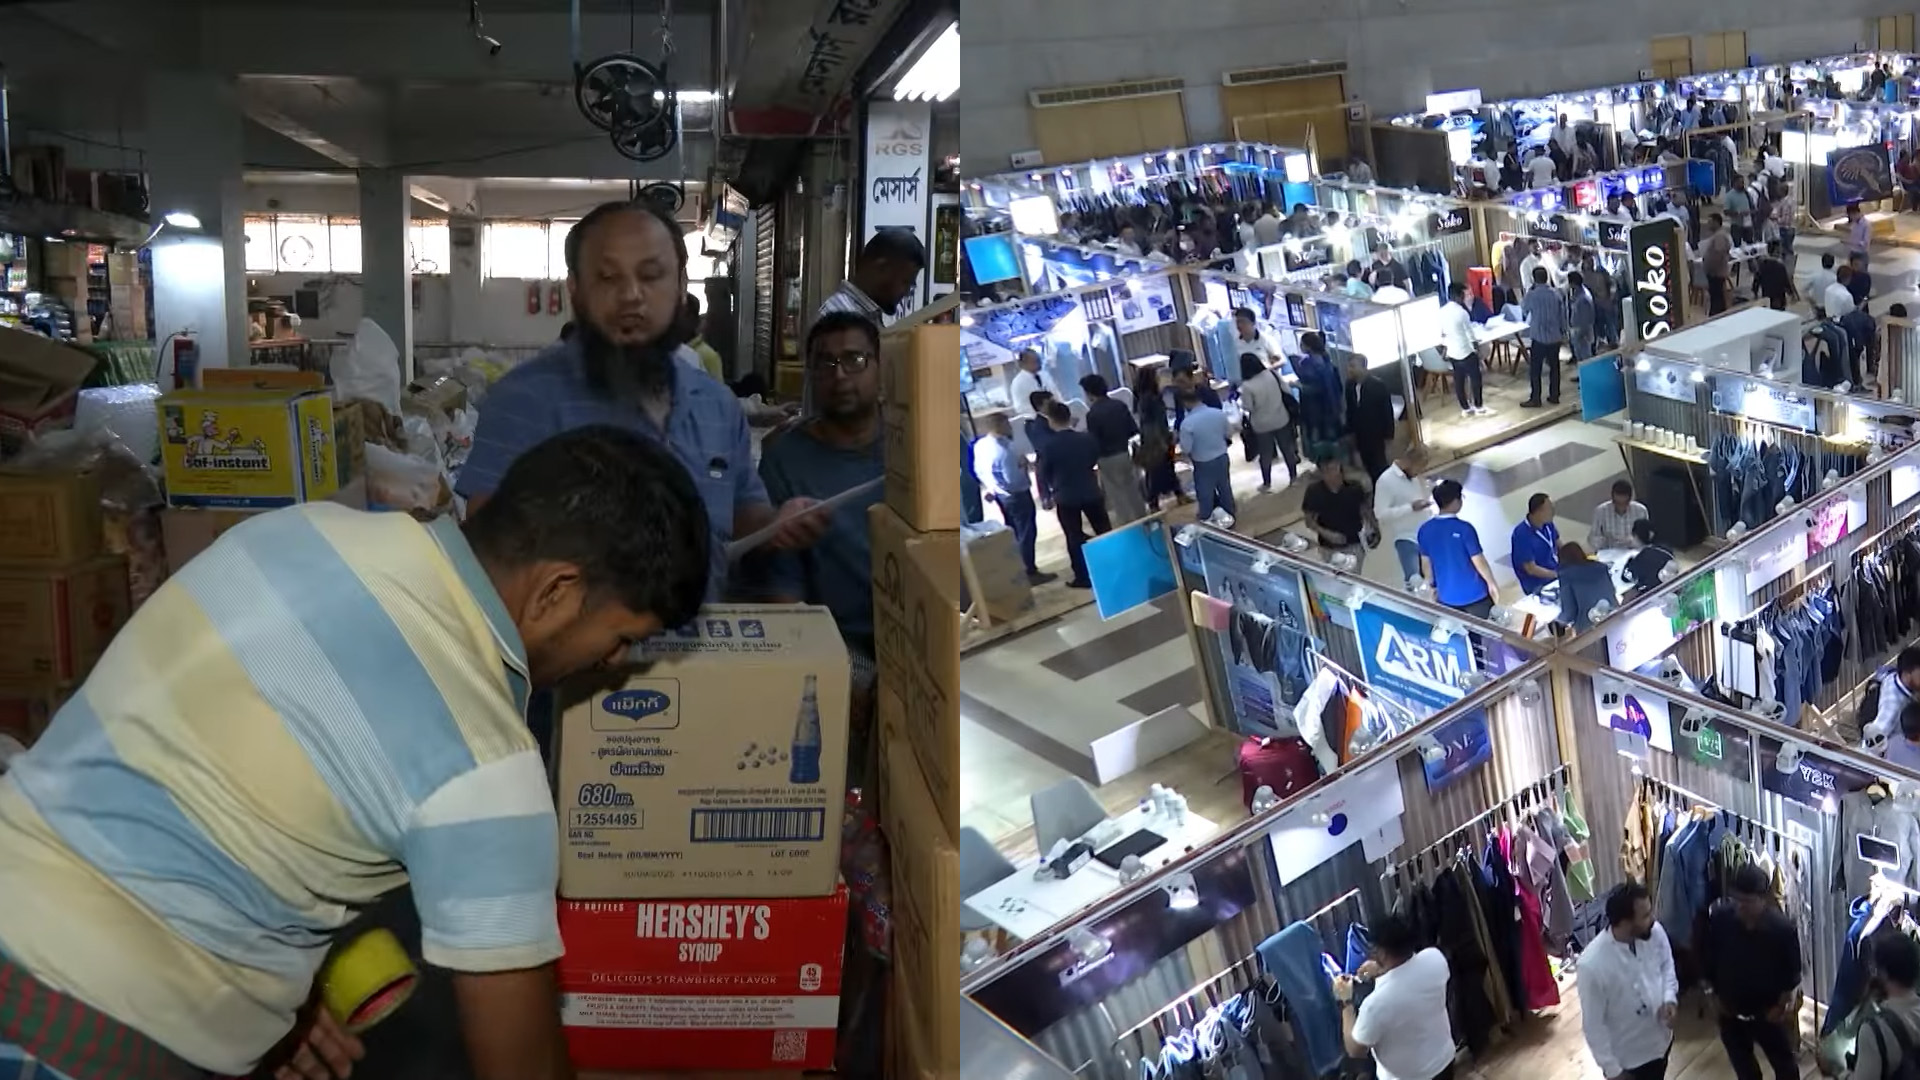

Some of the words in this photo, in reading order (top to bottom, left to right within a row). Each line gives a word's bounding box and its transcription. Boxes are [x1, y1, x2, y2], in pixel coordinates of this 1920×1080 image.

[875, 143, 923, 157] RGS
[873, 166, 922, 205] মেসার্স
[1607, 226, 1629, 242] Sok
[1637, 245, 1671, 341] Soko
[184, 457, 269, 469] saf-instant
[1376, 622, 1460, 688] ARM
[578, 783, 616, 807] 680
[576, 813, 638, 826] 12554495
[770, 850, 785, 858] LOT
[636, 902, 771, 940] HERSHEY'S
[678, 942, 723, 962] SYRUP
[591, 973, 652, 984] DELICIOUS
[656, 974, 730, 985] STRAWBERRY
[733, 975, 777, 985] FLAVOR
